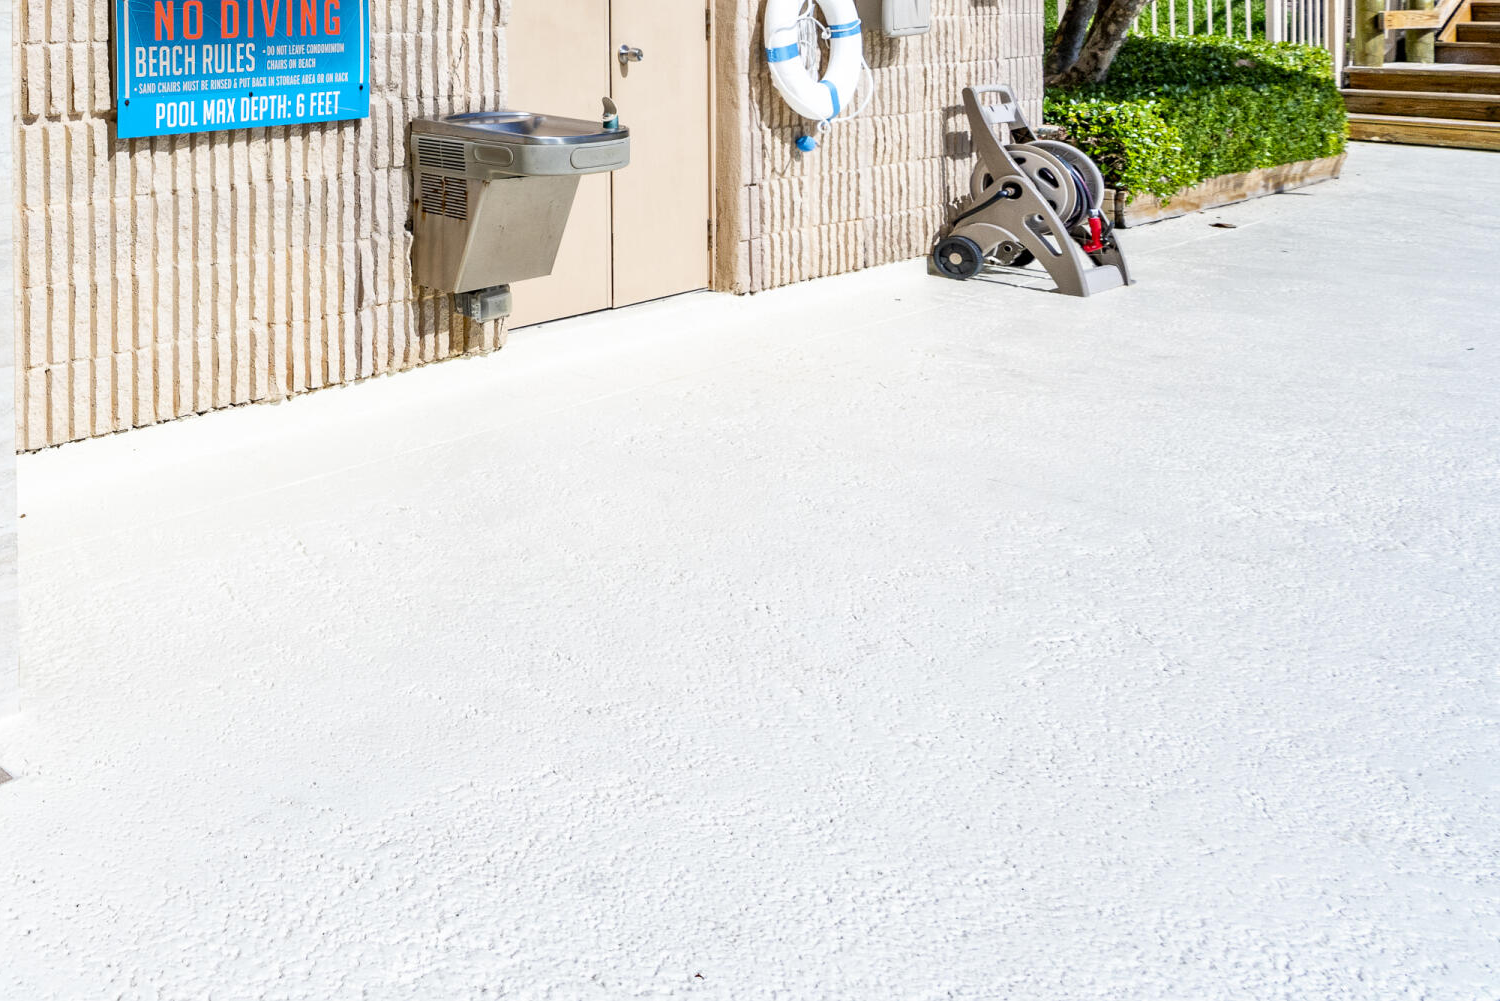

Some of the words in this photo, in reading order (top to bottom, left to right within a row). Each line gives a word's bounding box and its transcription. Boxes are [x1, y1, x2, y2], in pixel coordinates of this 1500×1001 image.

[154, 0, 203, 40] NO
[135, 45, 195, 77] BEACH
[202, 42, 255, 73] RULES
[155, 100, 197, 128] POOL
[202, 97, 235, 124] MAX
[240, 94, 291, 121] DEPTH:
[296, 93, 304, 117] 6
[309, 90, 340, 116] FEET
